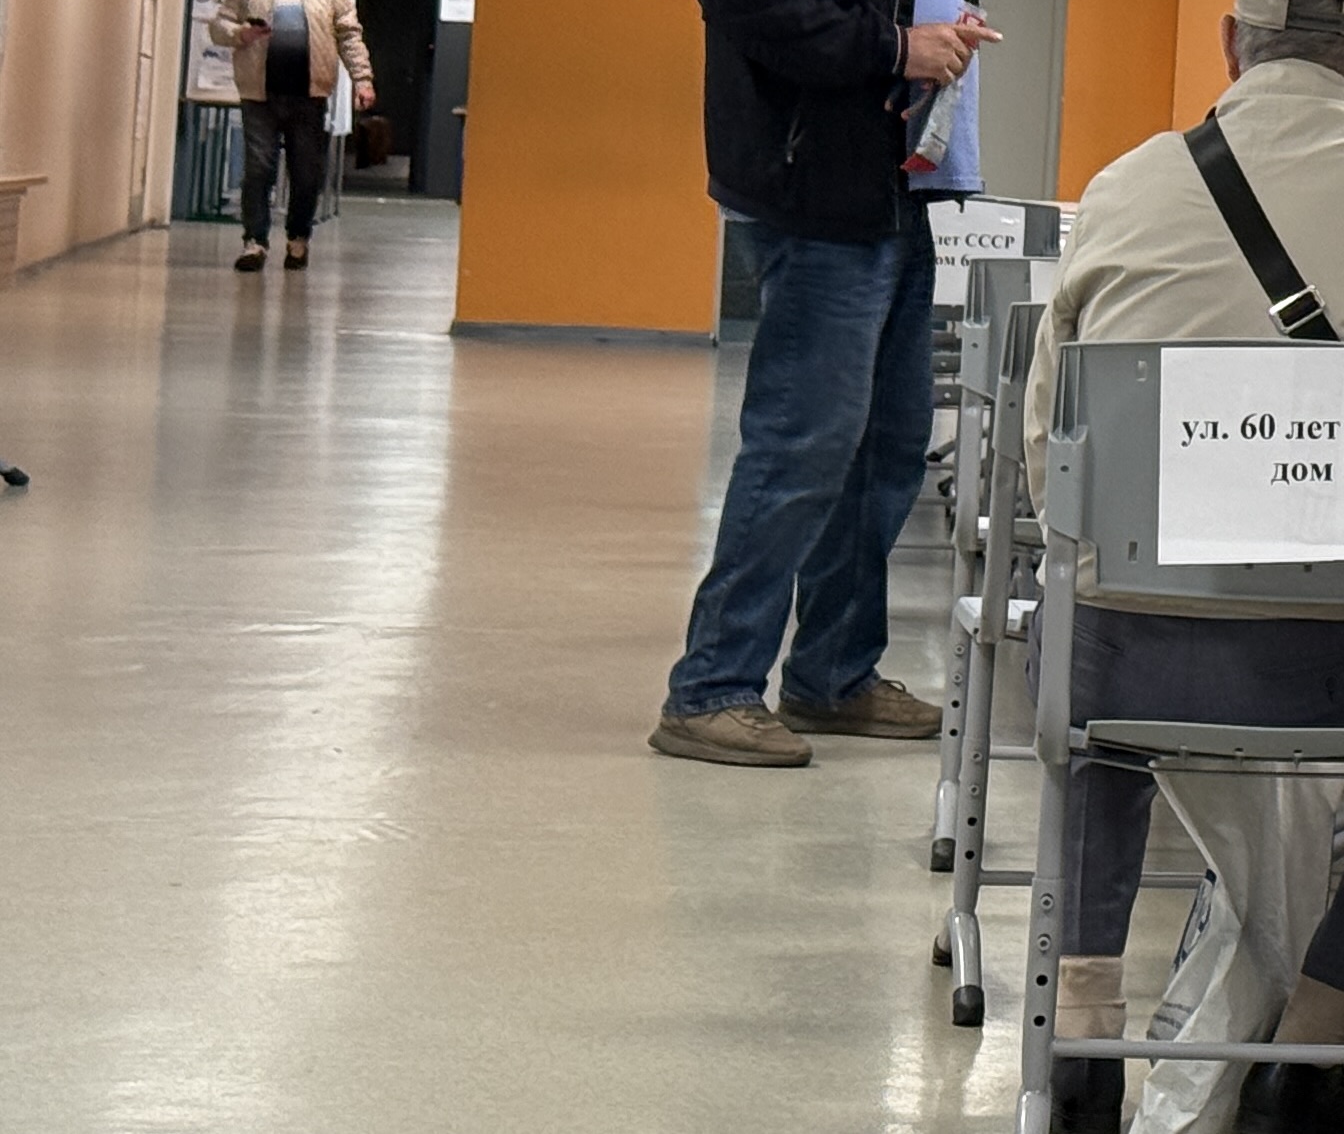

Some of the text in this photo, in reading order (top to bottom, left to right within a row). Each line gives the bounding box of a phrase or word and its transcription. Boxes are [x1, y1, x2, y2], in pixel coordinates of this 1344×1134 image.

[964, 233, 1016, 249] СССР
[934, 253, 971, 267] ом 6
[1180, 419, 1230, 448] ул.
[1239, 412, 1277, 441] 60
[1285, 419, 1341, 441] лет
[1270, 461, 1334, 486] дом
